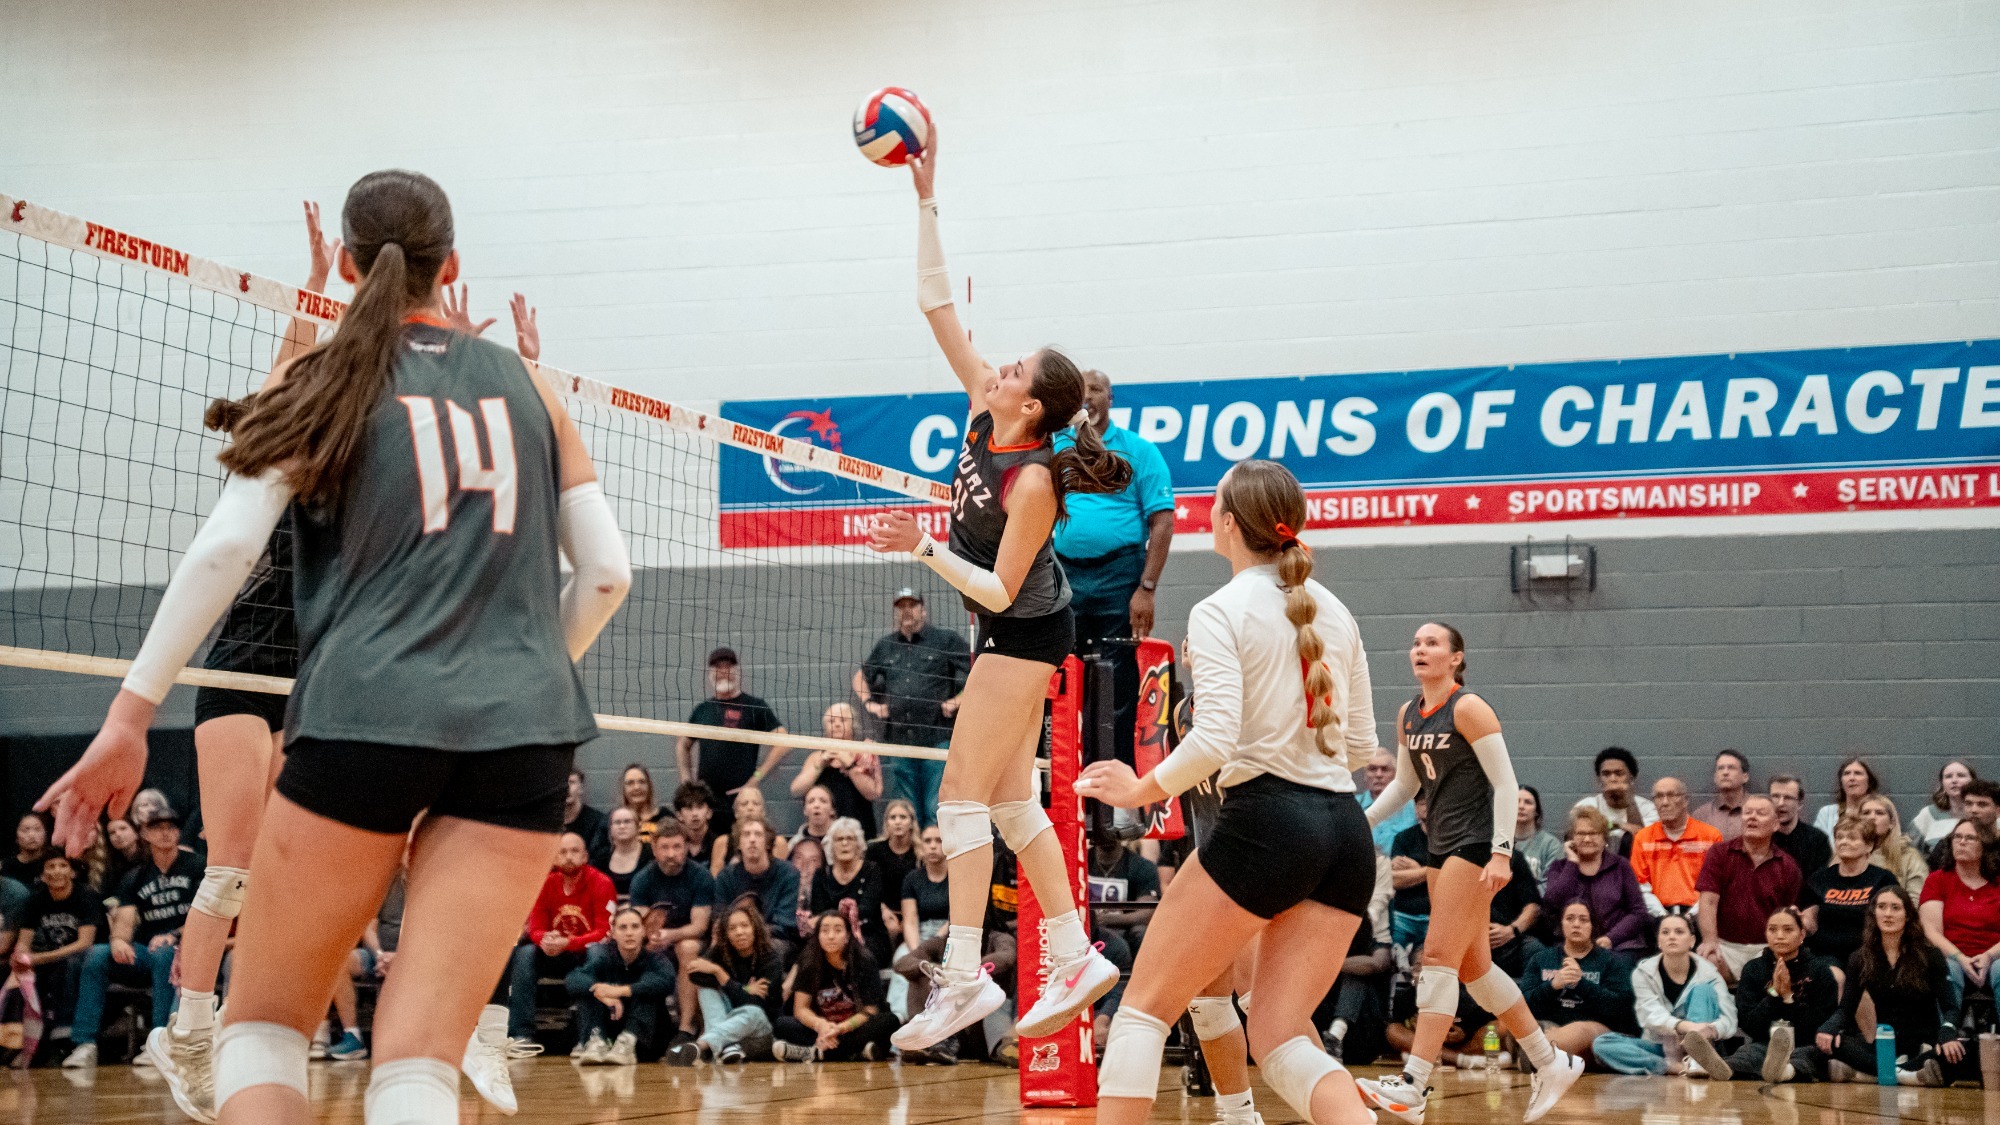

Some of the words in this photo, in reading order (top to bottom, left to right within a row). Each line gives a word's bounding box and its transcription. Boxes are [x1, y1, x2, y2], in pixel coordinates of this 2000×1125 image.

[84, 221, 189, 277] FIRESTORM
[296, 288, 348, 322] FIRES
[611, 387, 671, 422] FIRESTORM
[910, 397, 1379, 473] CPIONS
[1406, 388, 1516, 453] OF
[1540, 364, 2000, 448] CHARACTE
[732, 424, 784, 454] FIRESTORM
[397, 395, 518, 535] 14
[838, 455, 883, 482] FIRESTORM
[929, 482, 951, 501] FIRES
[1305, 493, 1438, 521] NSIBILITY
[1508, 482, 1761, 514] SPORTSMANSHIP
[1838, 473, 1979, 503] SERVANT
[1407, 733, 1451, 750] UAZ
[1420, 752, 1437, 780] 8
[137, 880, 157, 900] THE
